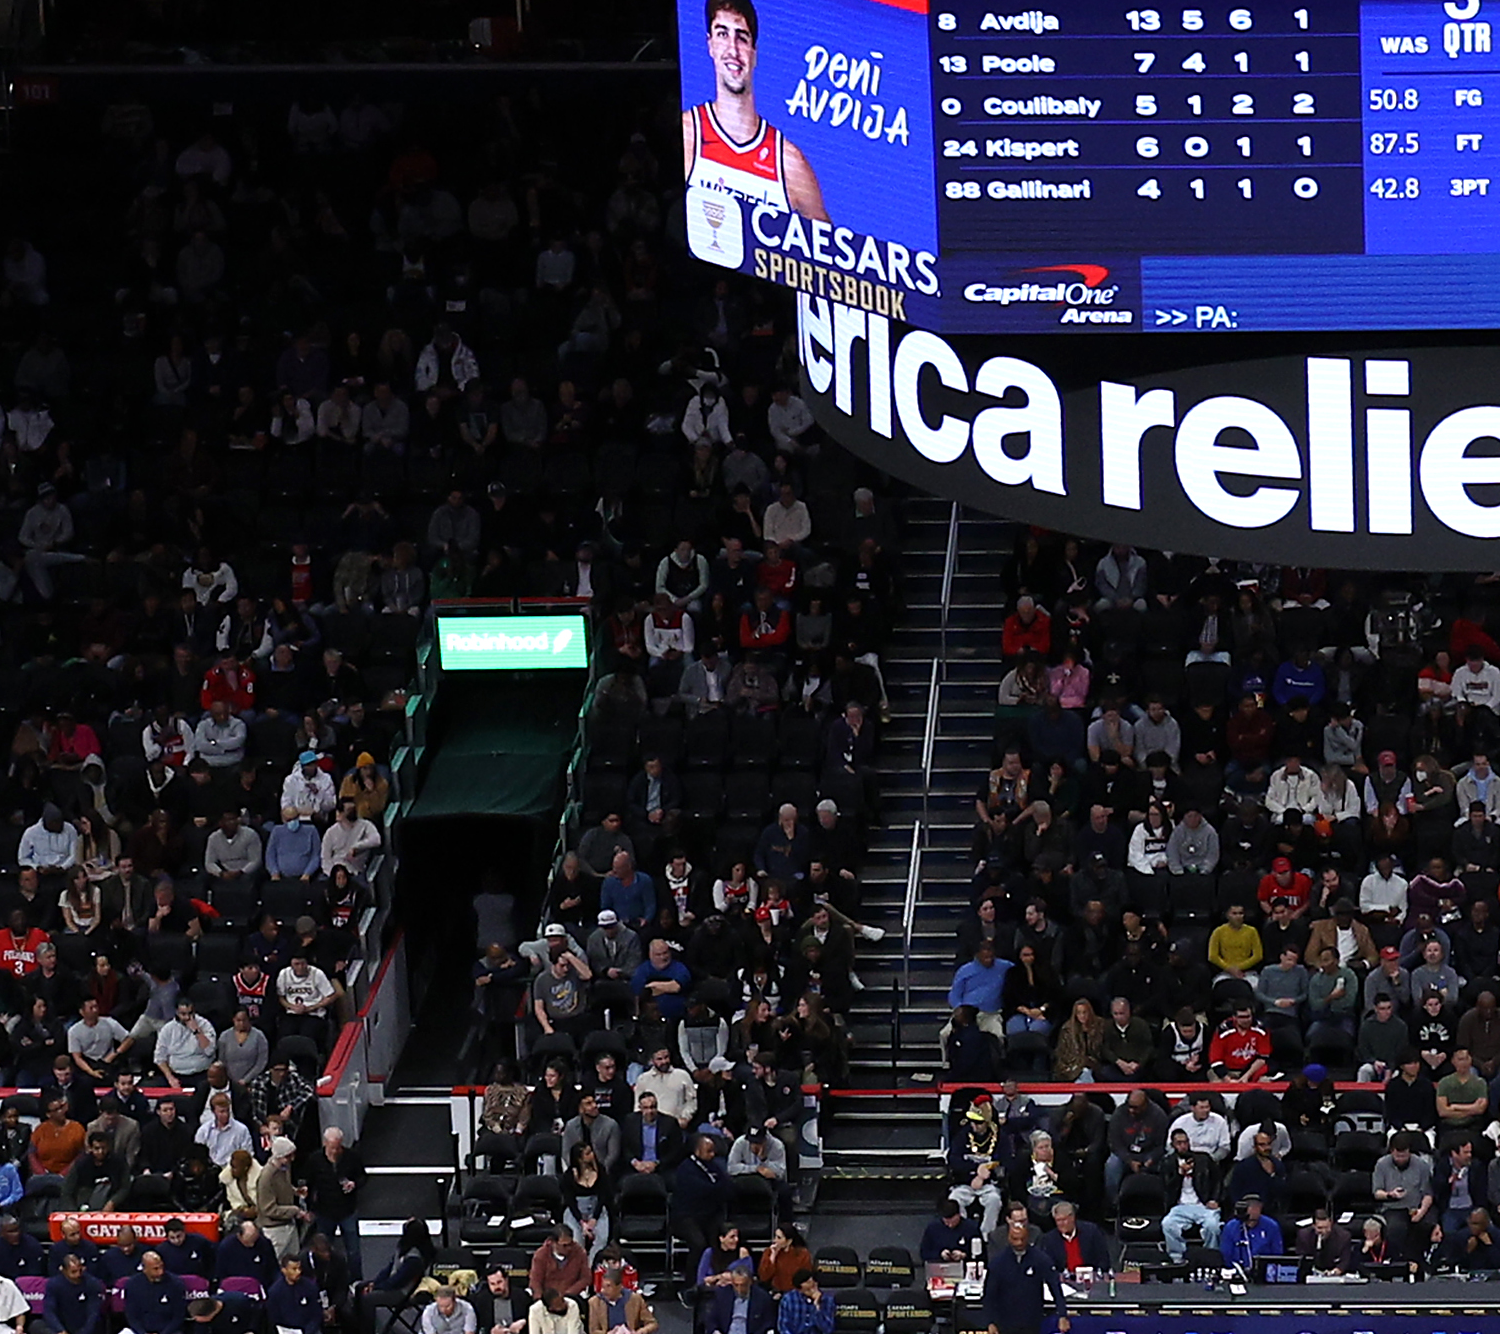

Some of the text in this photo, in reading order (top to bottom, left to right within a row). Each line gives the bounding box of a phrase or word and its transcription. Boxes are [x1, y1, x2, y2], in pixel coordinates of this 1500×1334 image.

[980, 10, 1060, 35] Avdija
[1380, 36, 1429, 54] WAS
[1443, 22, 1491, 59] QTR
[982, 54, 1056, 73] Poole
[983, 95, 1102, 119] Coulibaly
[1369, 88, 1419, 111] 50.8
[1454, 88, 1483, 107] FG
[985, 137, 1079, 161] Kispert
[1370, 132, 1419, 154] 87.5
[1456, 133, 1483, 152] FT
[986, 179, 1091, 199] Gallinari
[1369, 177, 1420, 199] 42.8
[1449, 178, 1490, 196] 3PT
[754, 248, 906, 321] SPORTSBOOK
[1060, 308, 1133, 324] Arena
[1195, 305, 1238, 329] PA:
[797, 291, 1067, 496] erica
[446, 632, 548, 652] Robinhood
